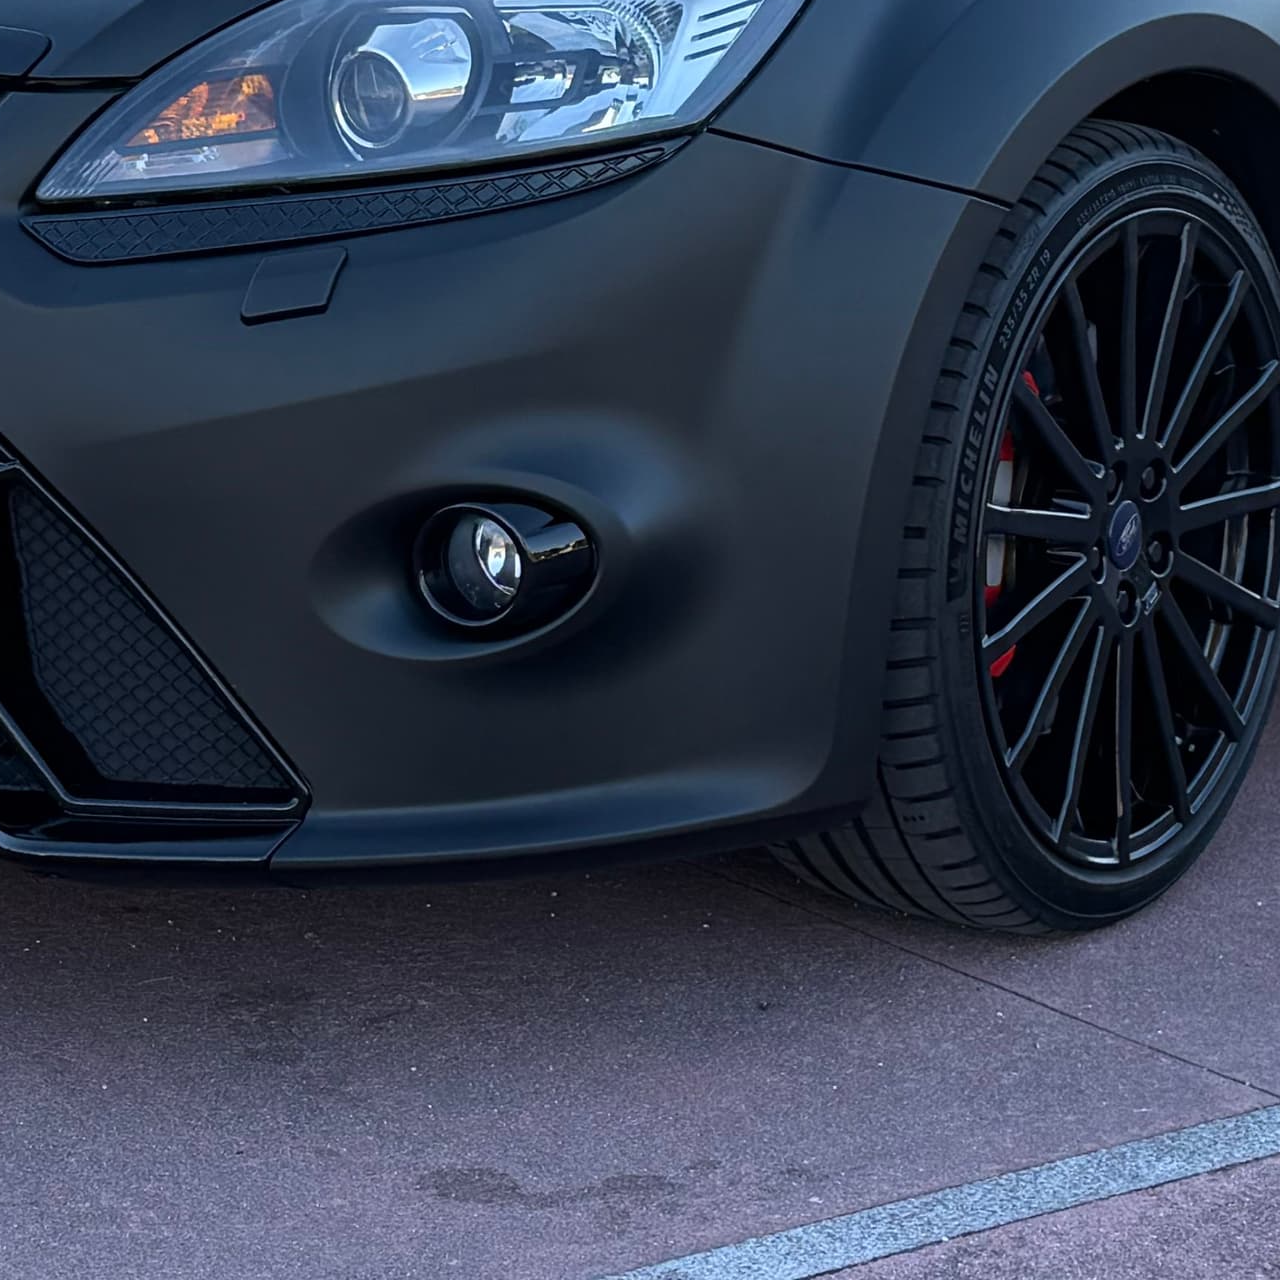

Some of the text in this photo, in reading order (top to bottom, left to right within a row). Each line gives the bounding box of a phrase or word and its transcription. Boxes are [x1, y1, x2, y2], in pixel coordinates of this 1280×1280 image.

[953, 364, 999, 544] MICHELIN
[999, 288, 1028, 350] 235/35
[1026, 267, 1040, 290] ZR
[1039, 249, 1051, 266] 19
